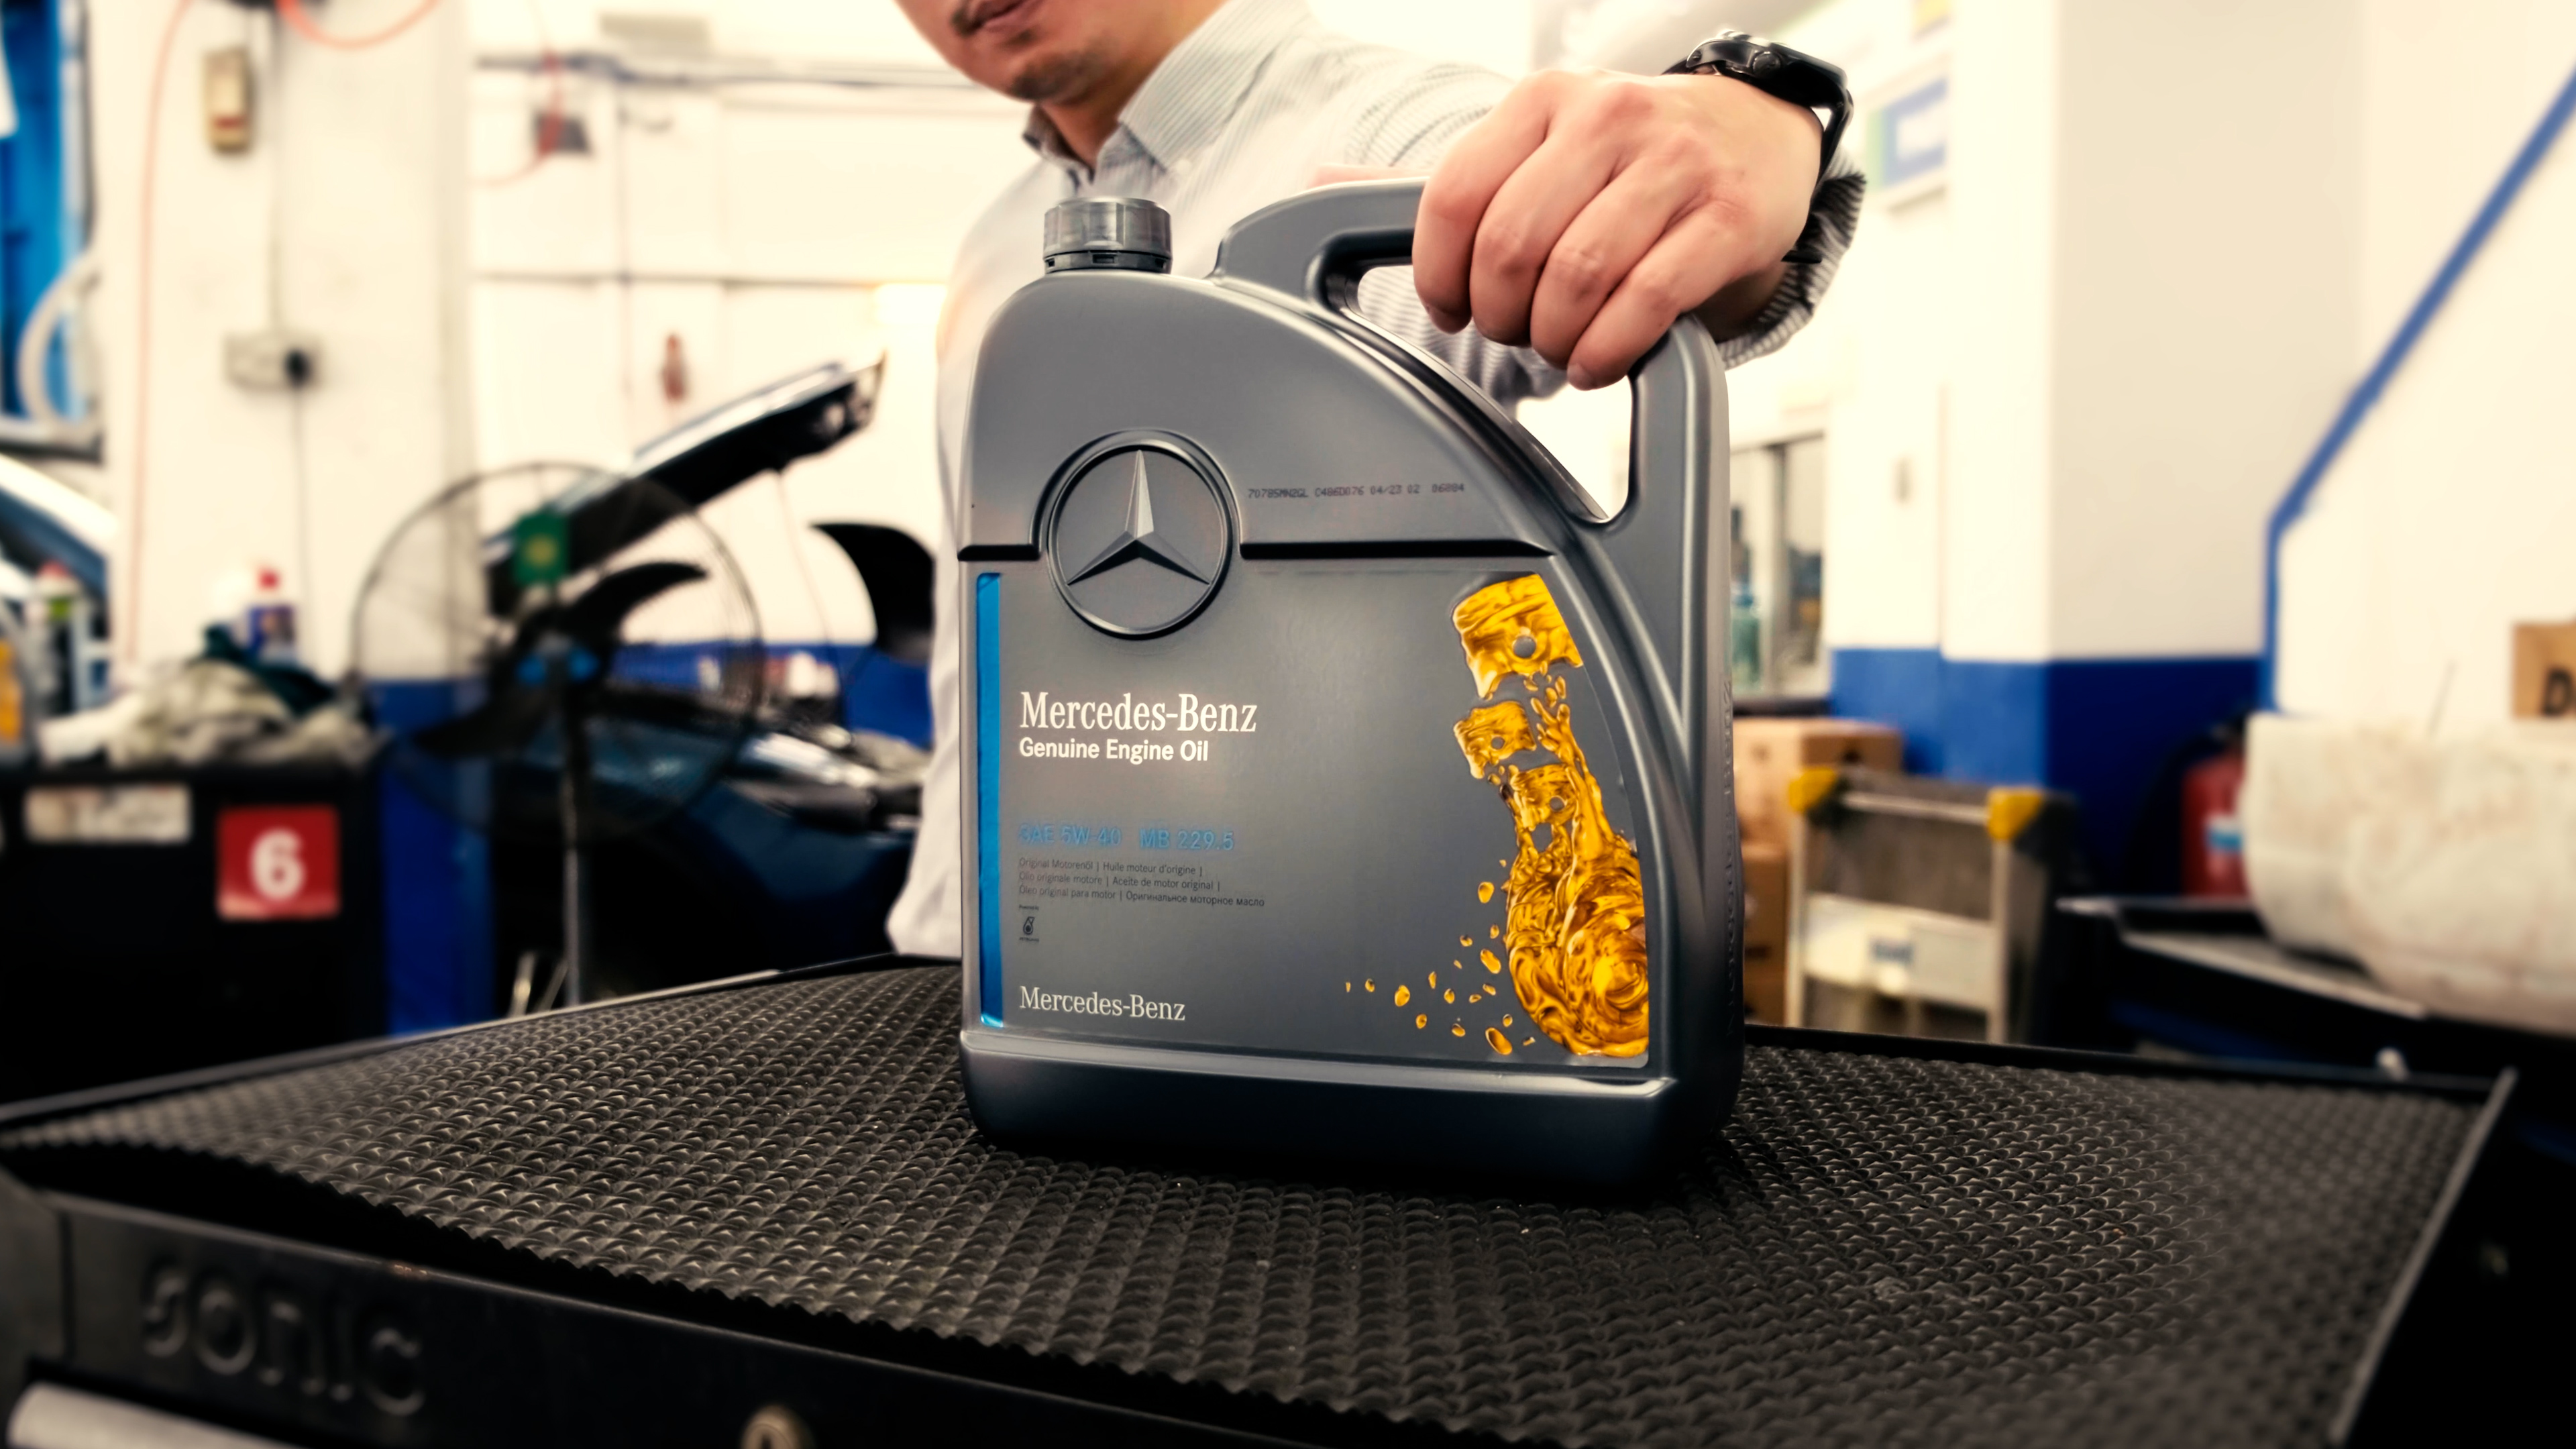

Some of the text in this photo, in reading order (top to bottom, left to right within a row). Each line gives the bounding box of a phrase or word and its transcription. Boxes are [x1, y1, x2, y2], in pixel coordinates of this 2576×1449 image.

[1371, 484, 1401, 495] 04/23
[1407, 484, 1420, 494] 02
[2540, 667, 2576, 717] D
[1020, 692, 1258, 732] Mercedes-Benz
[1019, 737, 1208, 765] Genuine Engine Oil
[1018, 823, 1234, 851] SAE 5W-40 MB 229.5
[248, 827, 305, 900] 6
[1019, 857, 1049, 869] Original
[1103, 862, 1124, 871] Huile
[1126, 863, 1156, 873] moteur
[1019, 871, 1213, 891] Olio originale motore Aceite de motor original
[1019, 883, 1116, 899] Óleo original para motor
[1126, 891, 1265, 906] Оригинальное моторное масло
[1020, 985, 1185, 1021] Mercedes-Benz
